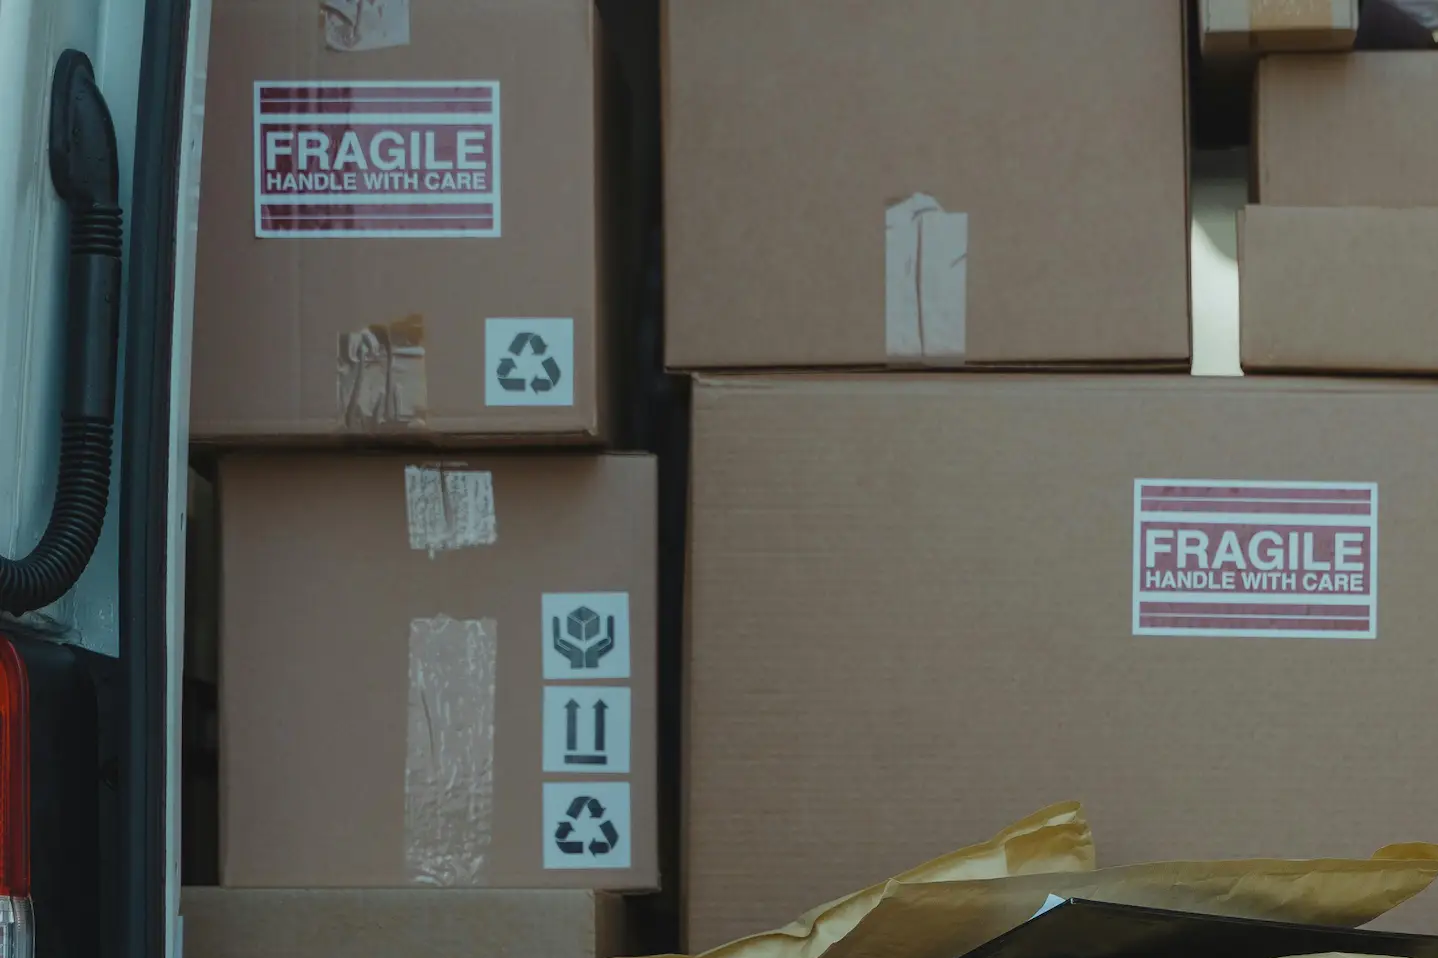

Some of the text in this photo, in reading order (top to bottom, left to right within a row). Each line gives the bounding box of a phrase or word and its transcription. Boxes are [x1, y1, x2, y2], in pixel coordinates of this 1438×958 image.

[266, 130, 487, 170] FRAGILE
[266, 172, 487, 191] HANDLE WITH CARE
[1145, 529, 1365, 571] FRAGILE
[1145, 570, 1364, 592] HANDLE WITH CARE
